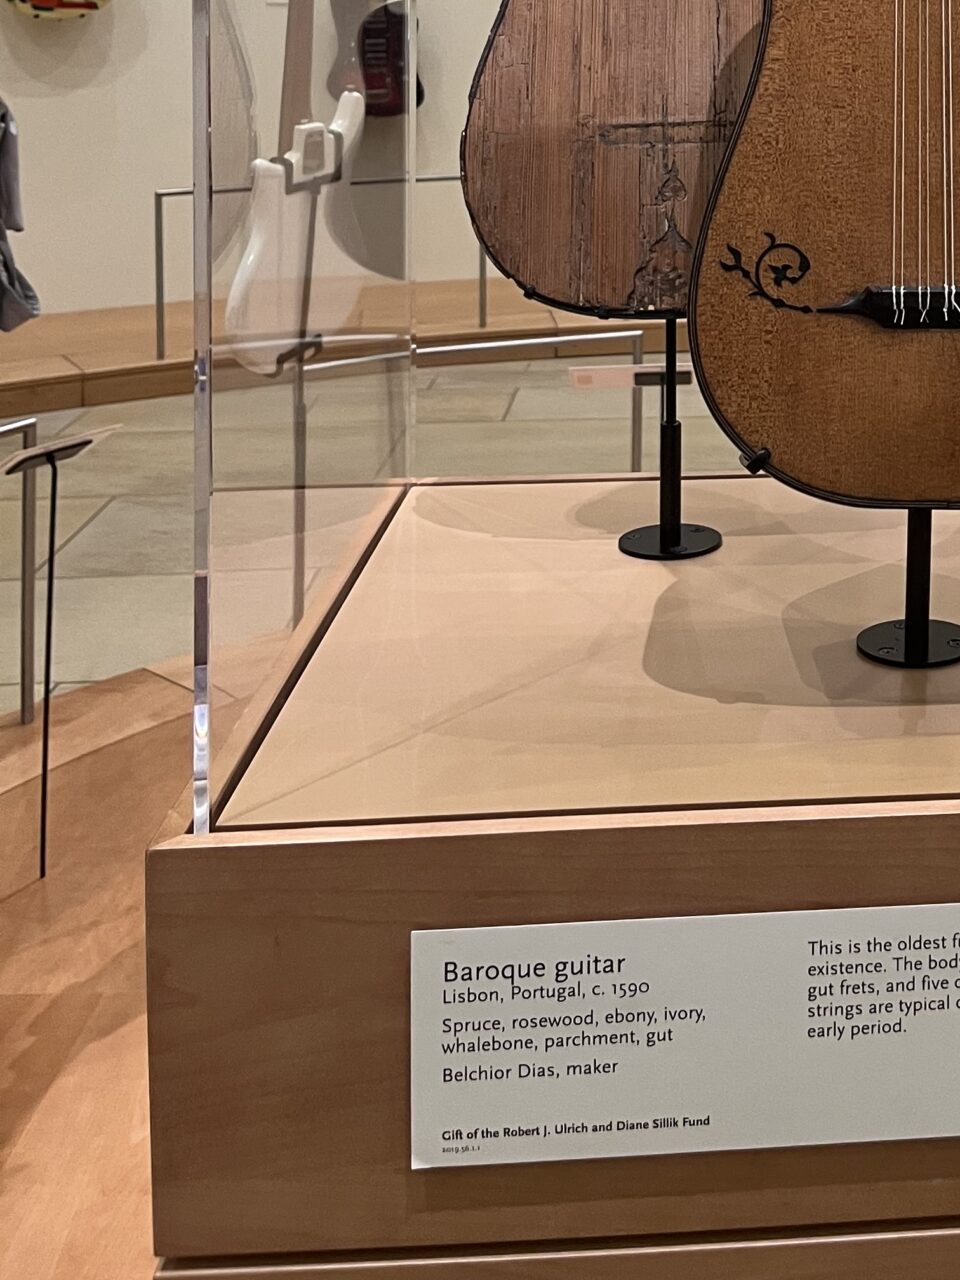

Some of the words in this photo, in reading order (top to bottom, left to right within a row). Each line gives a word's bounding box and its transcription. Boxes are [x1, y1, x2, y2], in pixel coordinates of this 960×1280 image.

[808, 940, 842, 955] This
[849, 940, 860, 953] is
[867, 937, 892, 952] the
[898, 935, 946, 950] oldest
[445, 962, 545, 985] Baroque
[555, 954, 625, 983] guitar
[808, 961, 886, 976] existence.
[892, 956, 922, 971] The
[444, 987, 503, 1004] Lisbon,
[511, 981, 585, 1002] Portugal,
[592, 985, 604, 995] c.
[612, 982, 649, 998] 1590
[808, 983, 834, 1001] gut
[840, 979, 879, 996] frets,
[886, 976, 915, 992] and
[922, 975, 949, 990] five
[808, 1002, 862, 1020] strings
[869, 1003, 893, 1014] are
[899, 995, 949, 1016] typical
[443, 1018, 505, 1037] Spruce,
[513, 1010, 598, 1029] rosewood,
[605, 1008, 657, 1026] ebony,
[665, 1007, 705, 1023] ivory,
[808, 1021, 845, 1040] early
[851, 1017, 906, 1040] period.
[442, 1035, 537, 1054] whalebone,
[545, 1031, 639, 1052] parchment,
[647, 1029, 673, 1047] gut
[443, 1065, 512, 1082] Belchior
[519, 1064, 559, 1078] Dias,
[567, 1059, 618, 1075] maker
[442, 1129, 463, 1140] Gift
[467, 1128, 479, 1139] of
[481, 1128, 499, 1138] the
[504, 1126, 540, 1137] Robert
[544, 1125, 550, 1137] J.
[555, 1123, 588, 1134] Ulrich
[592, 1121, 612, 1132] and
[617, 1120, 649, 1130] Diane
[653, 1118, 678, 1128] Sillik
[683, 1115, 709, 1127] Fund
